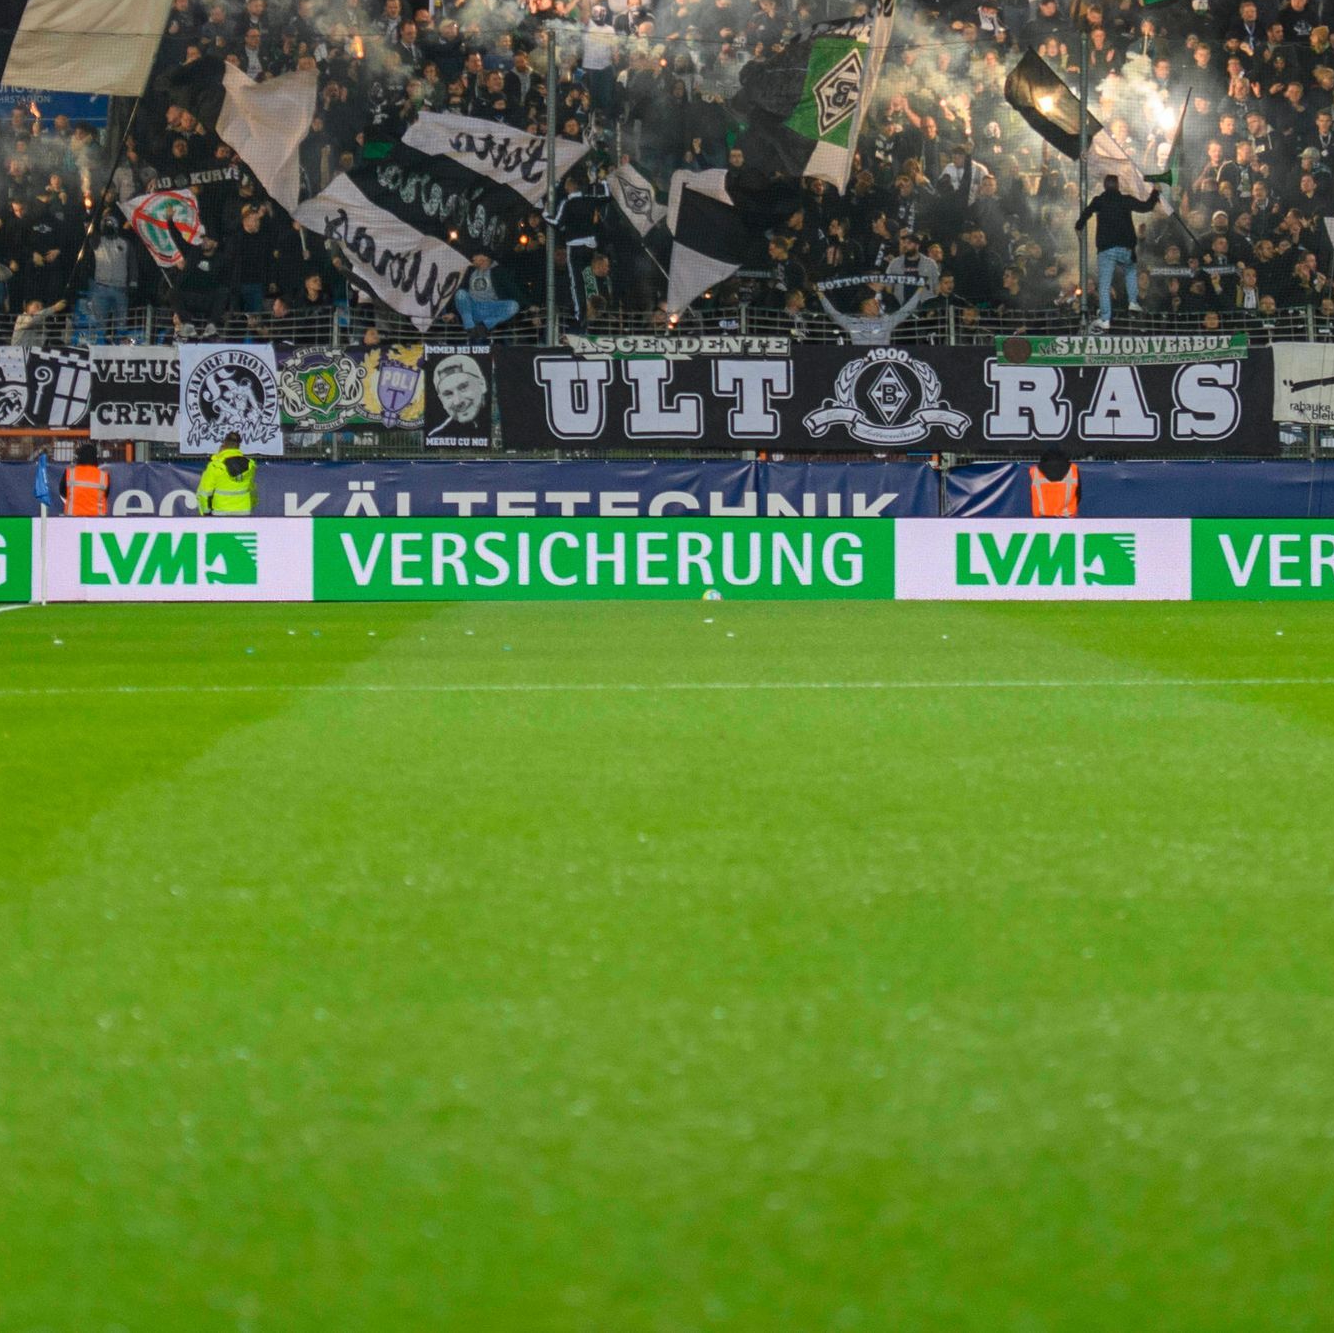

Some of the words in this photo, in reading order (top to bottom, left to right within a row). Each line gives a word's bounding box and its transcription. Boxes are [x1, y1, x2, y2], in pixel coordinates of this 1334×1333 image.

[816, 275, 927, 292] SOTTOCULTURA
[425, 346, 455, 355] IMMER
[457, 346, 471, 354] BEI
[472, 345, 490, 354] UNS
[574, 335, 791, 357] ASCENDENTE
[867, 348, 910, 361] 1900
[1055, 334, 1233, 356] STADIONVERBOT
[93, 359, 180, 383] VITUS
[380, 370, 416, 391] POLI
[535, 356, 793, 440] ULT
[983, 358, 1242, 441] RAS
[1289, 401, 1331, 415] rabauke
[95, 403, 179, 427] CREW
[426, 437, 456, 447] MEREU
[457, 437, 471, 447] CU
[471, 437, 488, 447] NOI
[79, 532, 199, 585] LVM
[340, 531, 864, 587] VERSICHERUNG
[955, 533, 1076, 586] LVM
